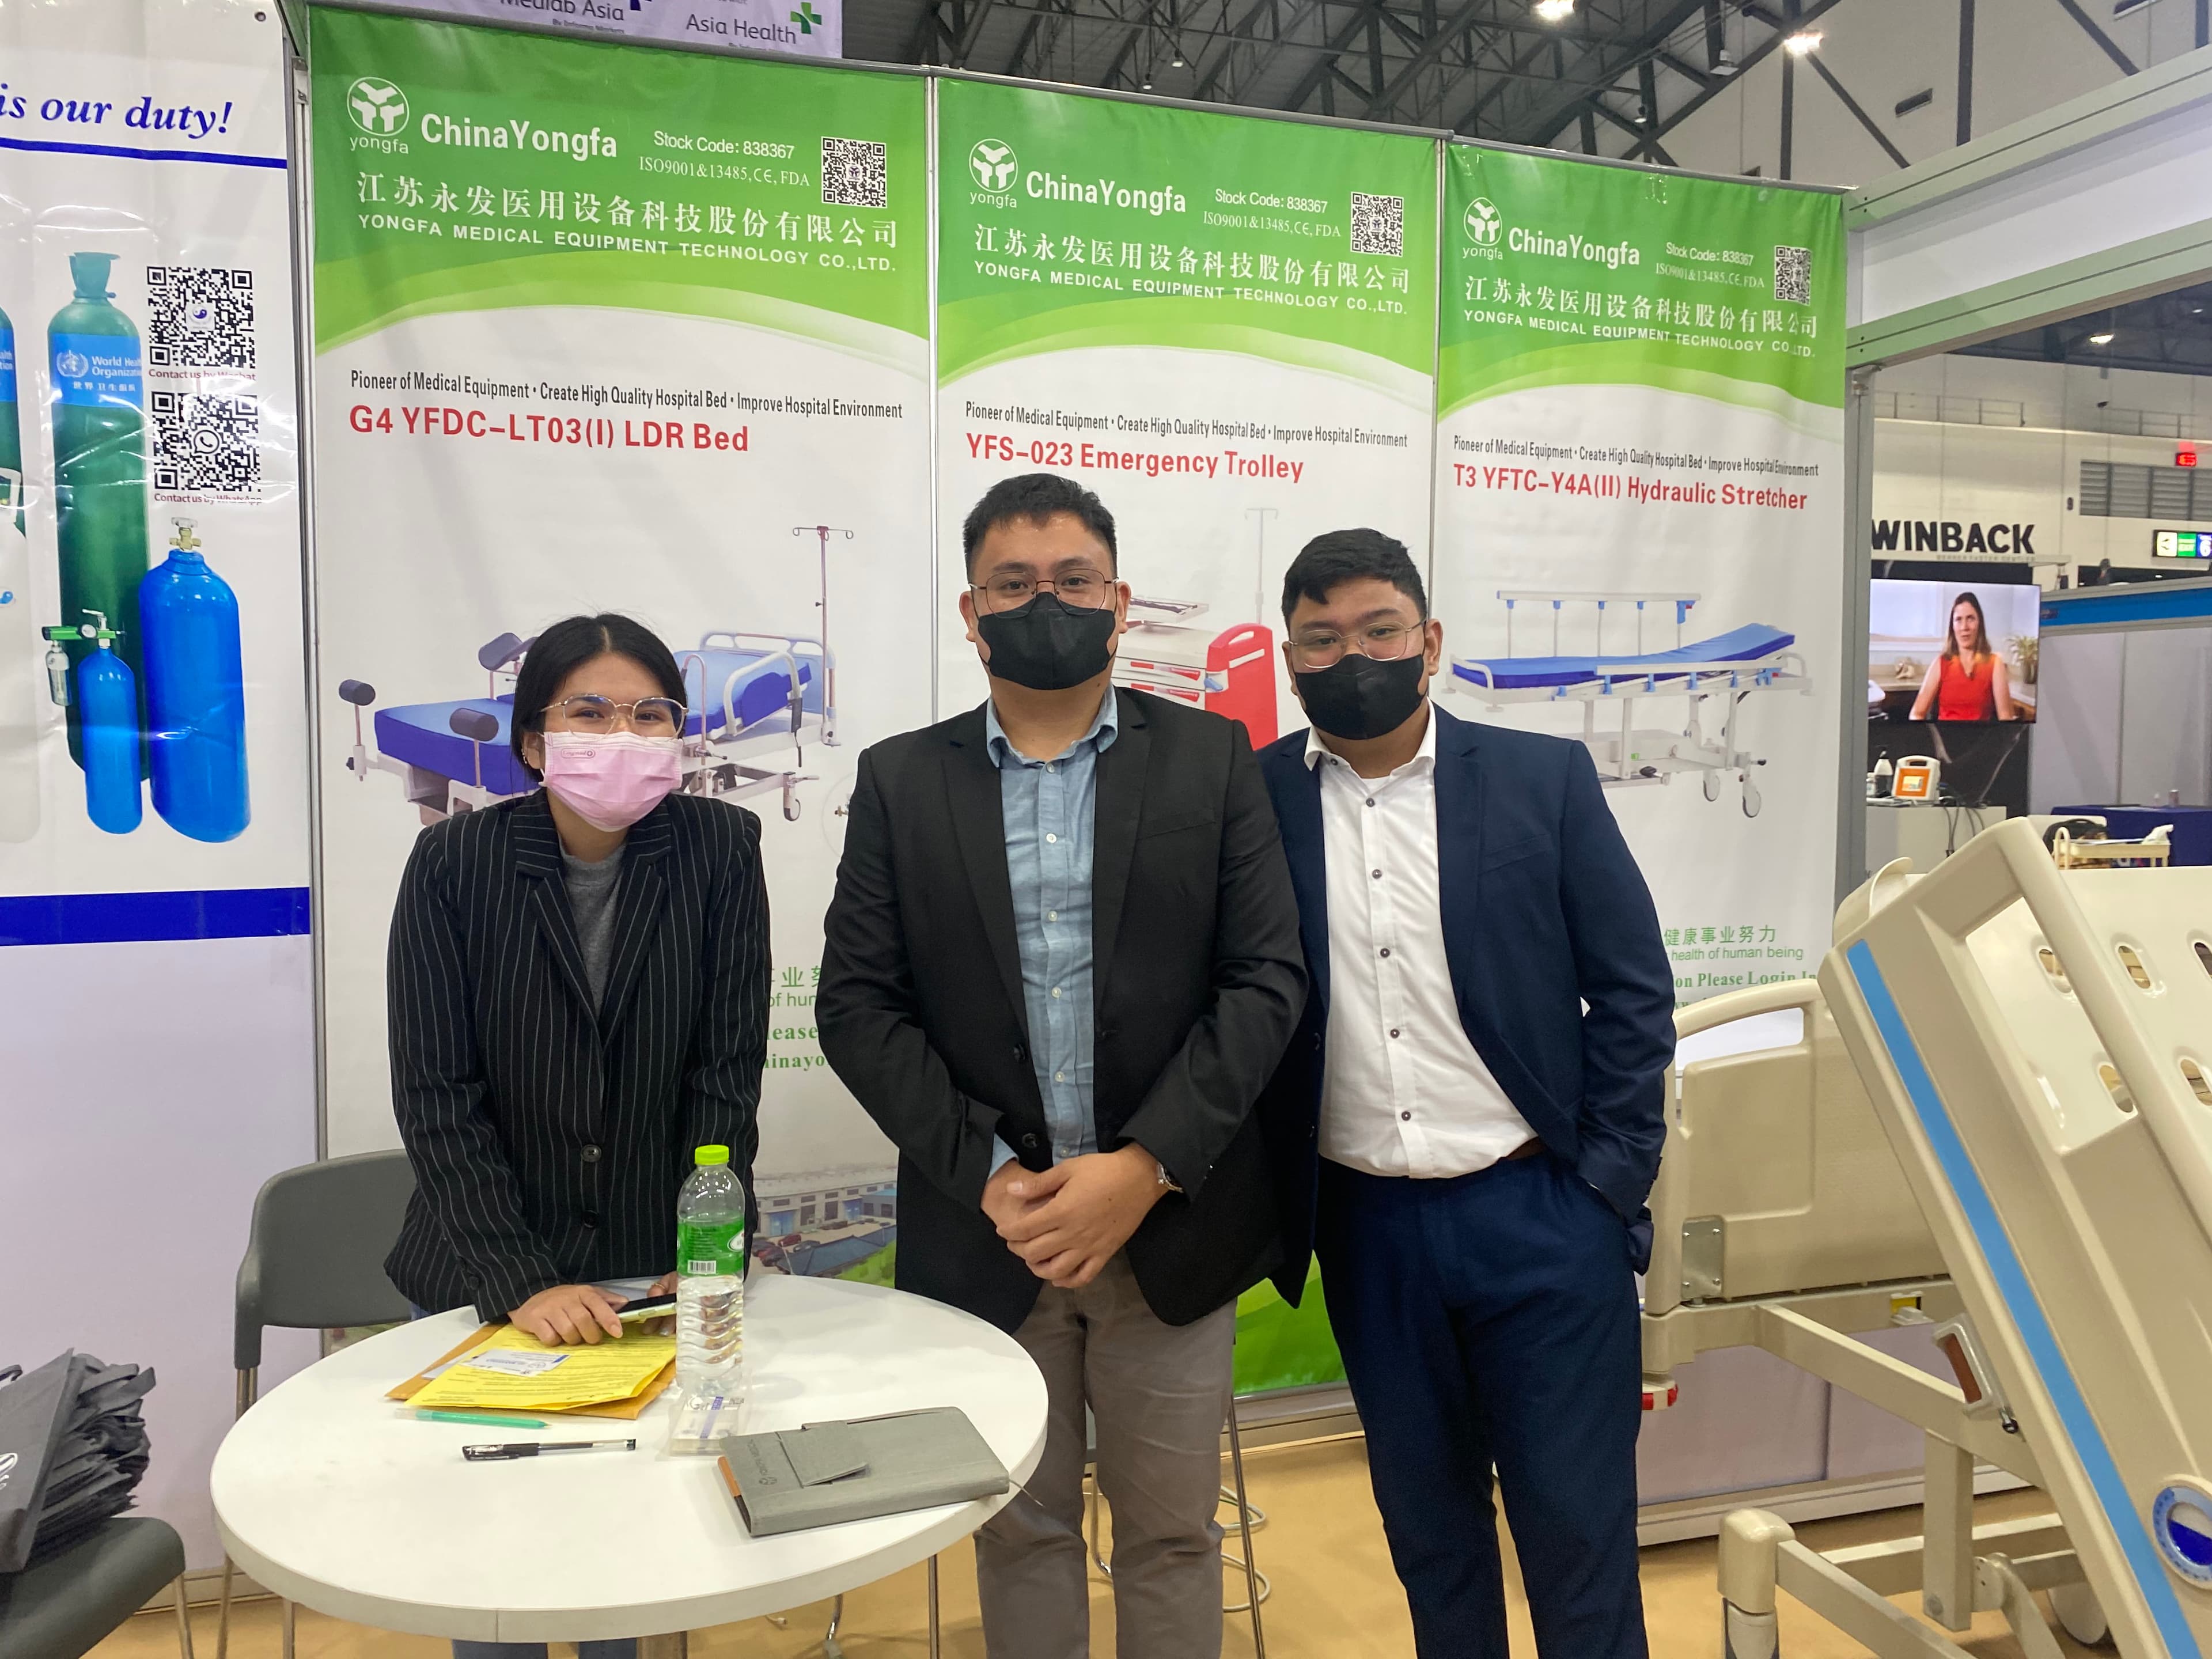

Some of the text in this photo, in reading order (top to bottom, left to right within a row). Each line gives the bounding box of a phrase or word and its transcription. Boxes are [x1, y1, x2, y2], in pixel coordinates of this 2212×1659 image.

[582, 0, 624, 21] Asia
[685, 14, 796, 44] Asia Health
[0, 83, 233, 139] is our duty!
[350, 136, 409, 154] yongfa
[421, 113, 617, 162] ChinaYongfa
[654, 130, 796, 160] Stock Code: 838367
[781, 170, 810, 187] FDA
[969, 191, 1017, 209] yongfa
[1026, 171, 1186, 217] ChinaYongfa
[1215, 188, 1328, 214] Stock Code: 838367
[357, 171, 897, 249] 江苏永发医用设备科技股份有限公司
[358, 214, 896, 271] YONGFA MEDICAL EQUIPMENT TECHNOLOGY CO.,LTD.
[1315, 224, 1342, 238] FDA
[974, 223, 1410, 294] 江苏永发医用设备科技股份有限公司
[1462, 247, 1503, 260] yongfa
[1508, 227, 1641, 270] ChinaYongfa
[1666, 242, 1754, 266] Stock Code: 838367
[974, 260, 1408, 315] YONGFA MEDICAL EQUIPMENT TECHNOLOGY CO.,LTD.
[1744, 276, 1764, 287] FDA
[1465, 275, 1817, 339] 江苏永发医用设备科技股份有限公司
[1464, 309, 1523, 327] YONGFA
[1529, 316, 1587, 335] MEDICAL
[1593, 325, 1671, 342] EQUIPMENT
[1675, 333, 1763, 351] TECHNOLOGY
[92, 356, 122, 366] World
[149, 369, 188, 378] Contact
[351, 369, 903, 419] Pioneer of Medical Equipment Create High Quality Hospital Bed Improve Hospital Environment
[349, 404, 393, 434] G4
[624, 420, 684, 449] LDR
[694, 422, 748, 452] Bed
[965, 400, 1408, 448] Pioneer of Medical Equipment Create High Quality Hospital Bed Improve Hospital Environment
[965, 433, 1304, 484] YFS-023 Emergency Trolley
[1453, 435, 1819, 476] Pioneer of Medical Equipment Create High Quality Hospital Bed Improve Hospital Environment
[154, 493, 190, 502] Contact
[1453, 463, 1476, 488] T3
[1627, 476, 1716, 505] Hydraulic
[1721, 483, 1808, 510] Stretcher
[1872, 520, 2036, 554] WINBACK
[1663, 924, 1776, 946] 健康事业努力
[1672, 946, 1804, 961] health of human being
[1697, 971, 1743, 987] Please
[1747, 971, 1796, 985] Login
[767, 1027, 818, 1040] ease
